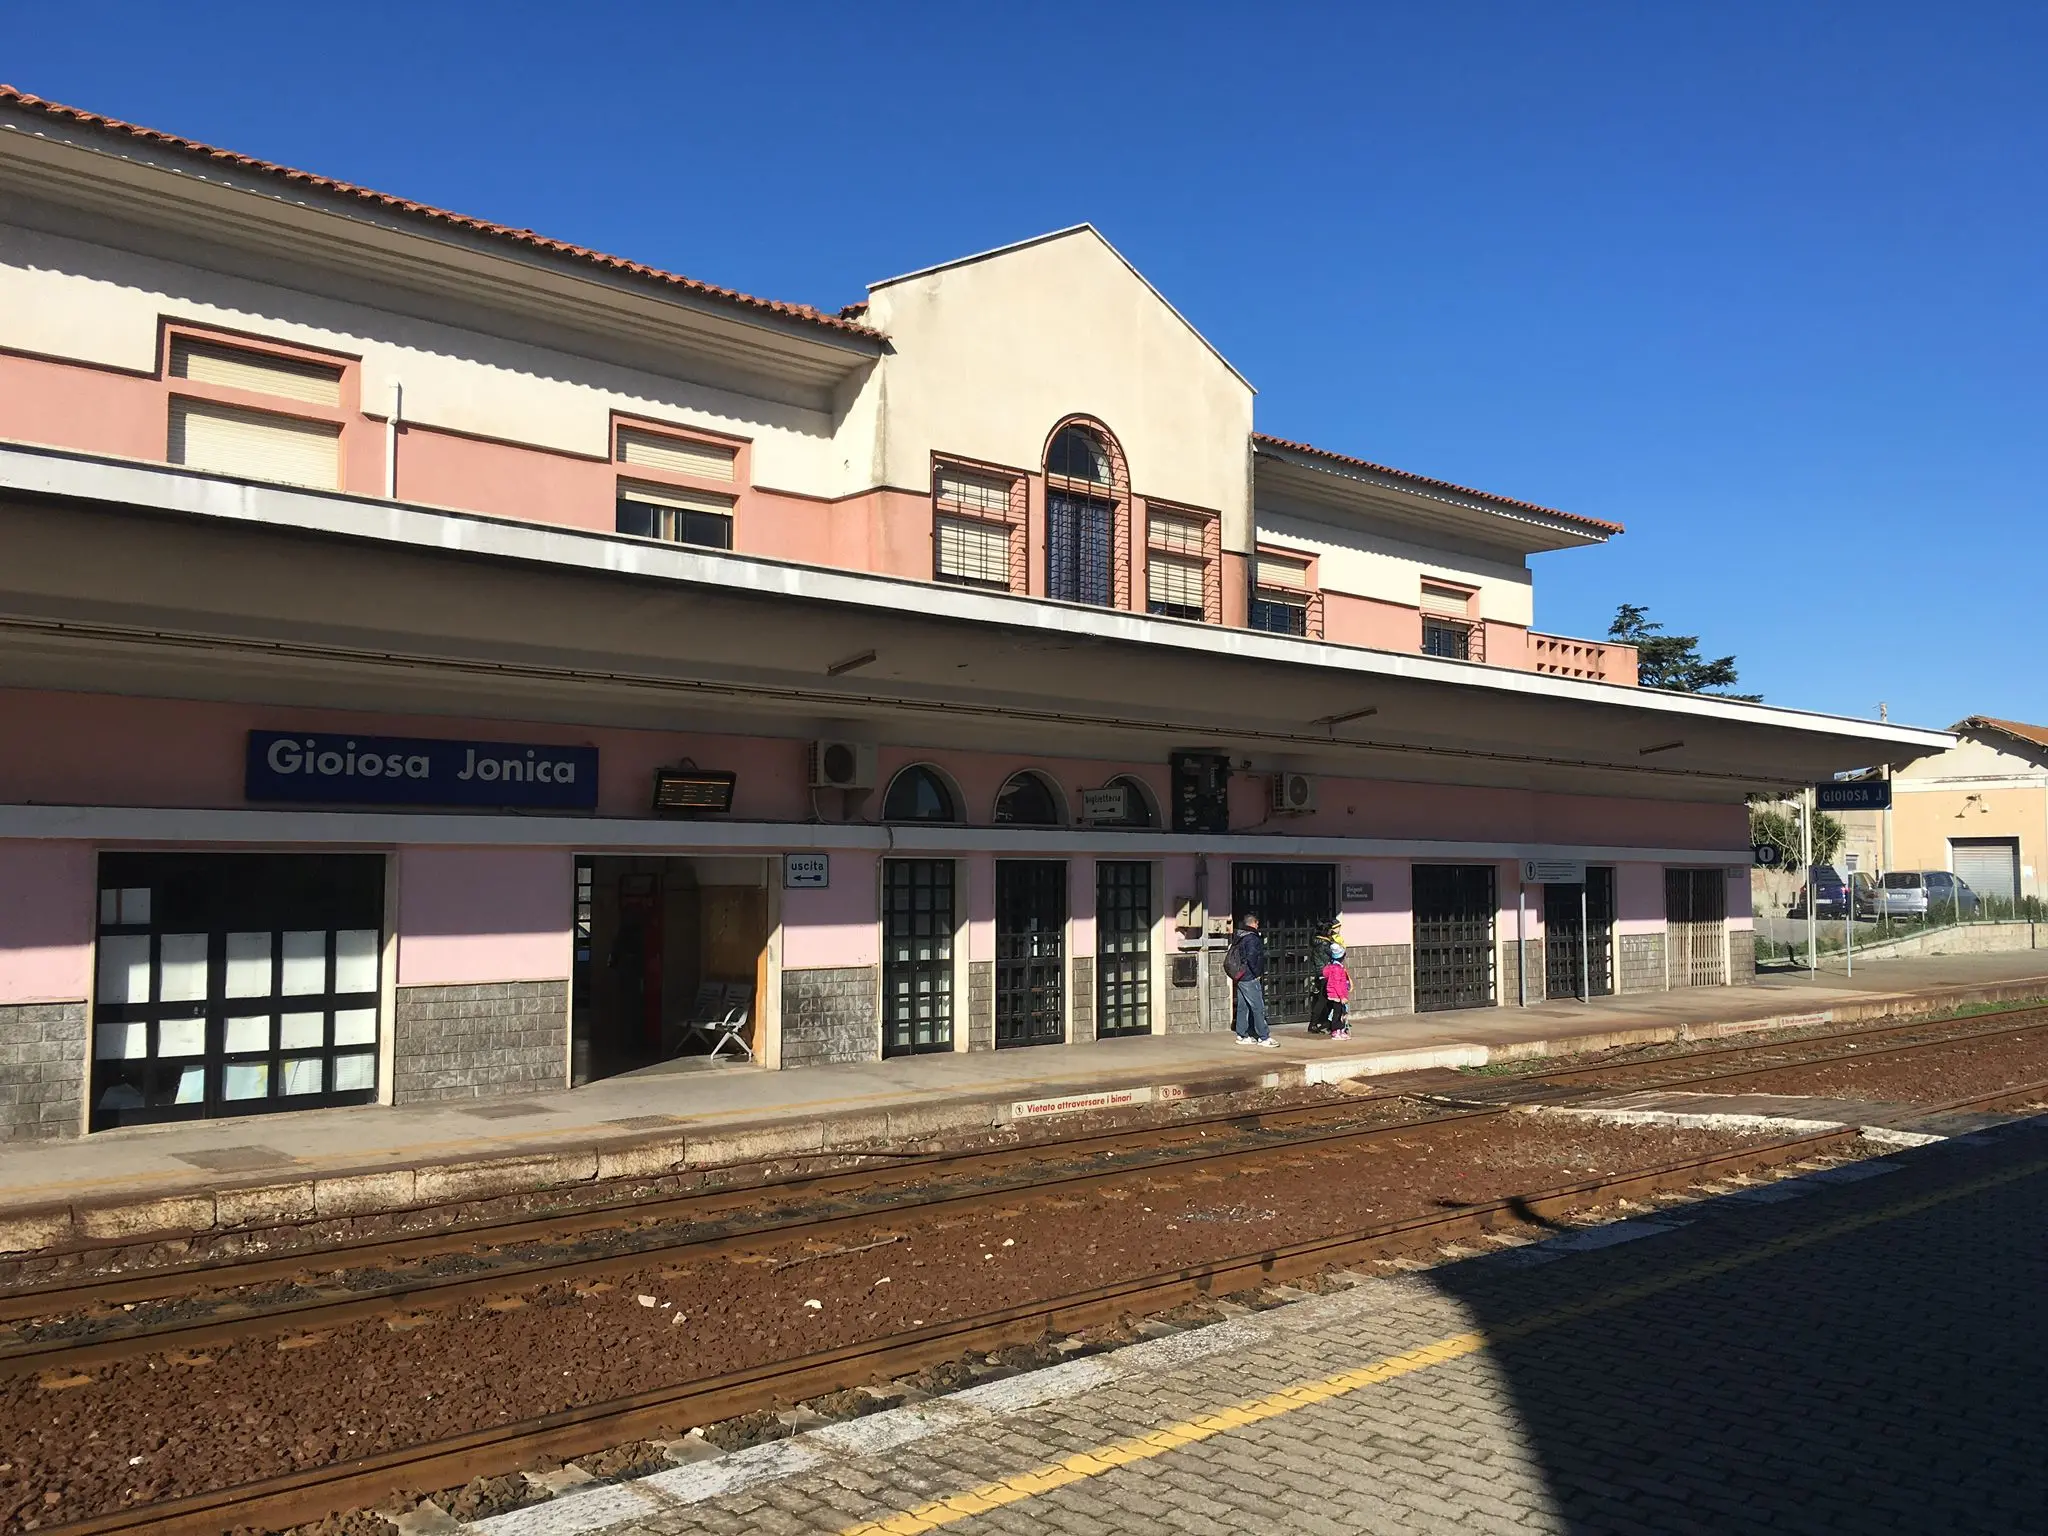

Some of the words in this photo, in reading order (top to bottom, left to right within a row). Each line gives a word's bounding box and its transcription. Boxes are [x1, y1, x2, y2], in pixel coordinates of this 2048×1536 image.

[267, 738, 430, 779] Gioiosa
[457, 748, 576, 783] Jonica
[1823, 789, 1869, 802] GIOIOSA
[791, 860, 824, 871] uscita
[1172, 1088, 1181, 1096] Do
[1027, 1104, 1056, 1113] Vietato
[1057, 1099, 1104, 1109] attraversare
[1111, 1092, 1132, 1103] binari
